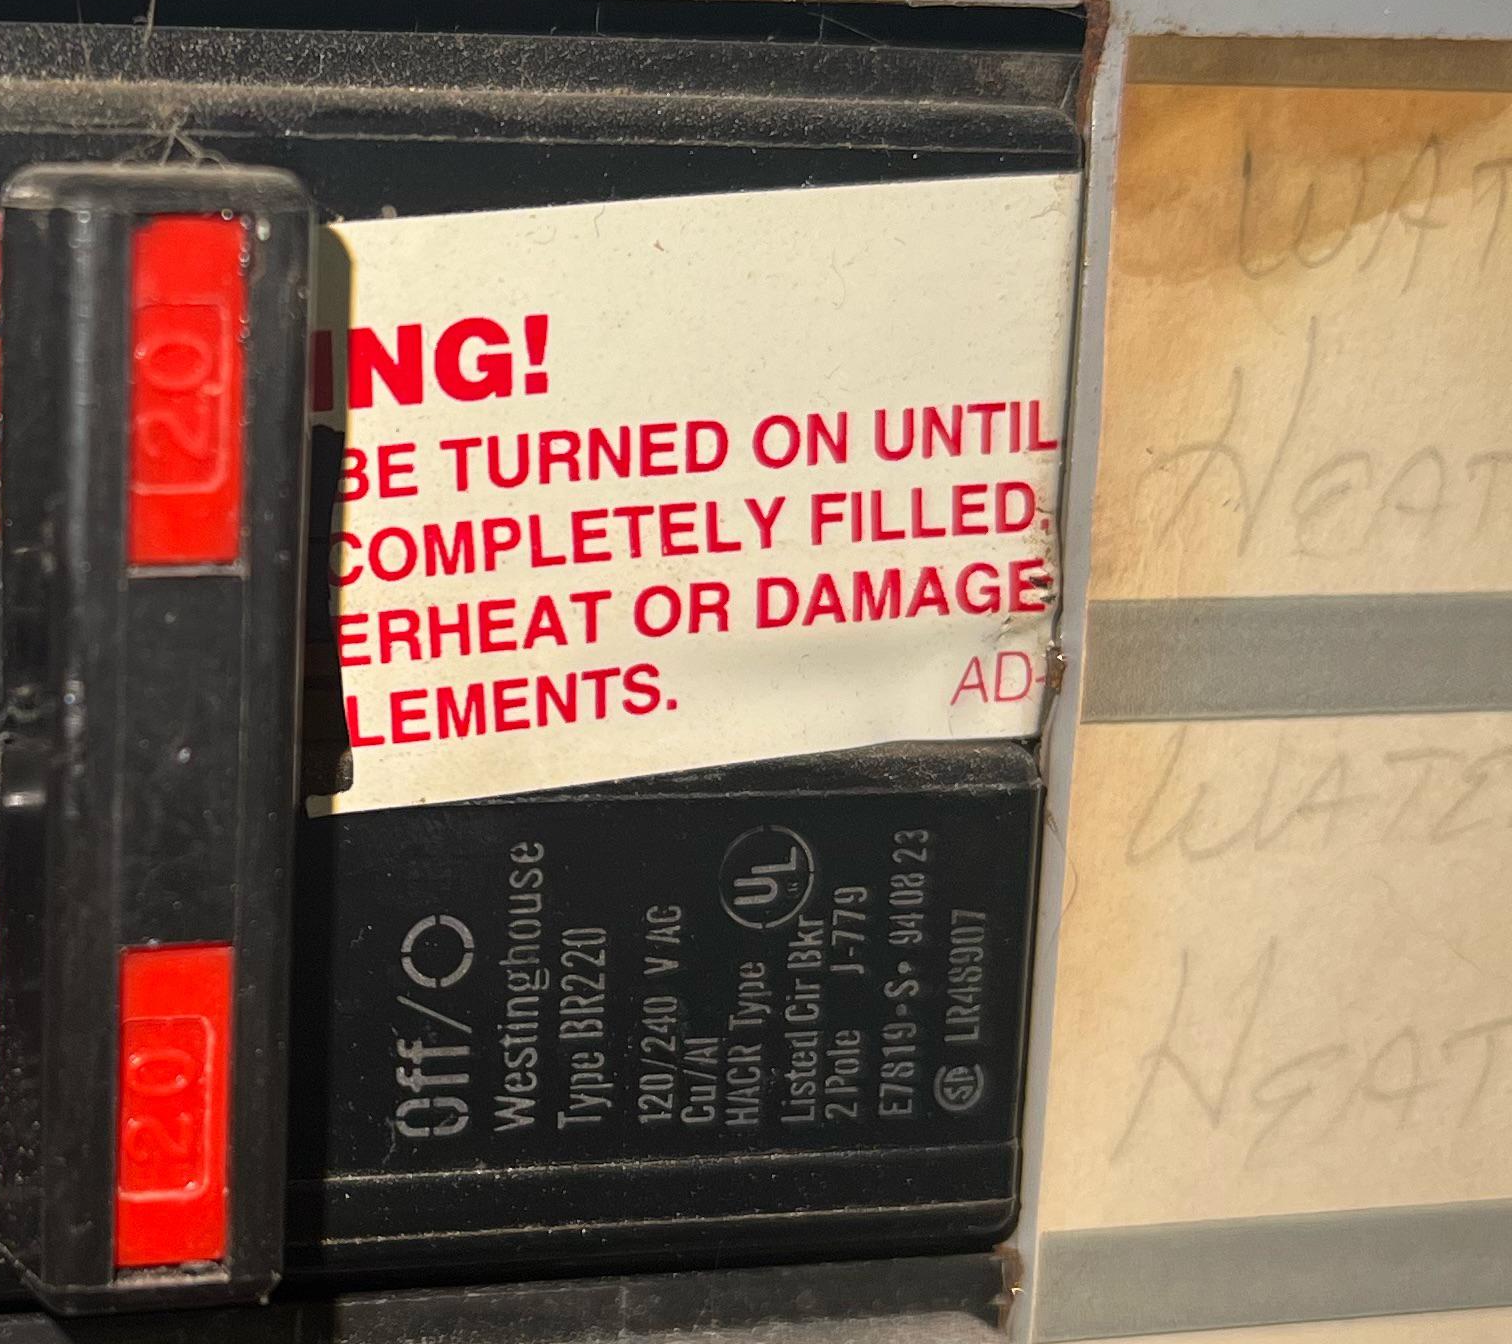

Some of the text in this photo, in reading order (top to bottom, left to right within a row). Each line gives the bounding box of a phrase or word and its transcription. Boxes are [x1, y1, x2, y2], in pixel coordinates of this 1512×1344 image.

[329, 480, 1051, 588] COMPLETELY FILLED.
[335, 399, 1058, 503] BE TURNED ON UNTIL
[634, 581, 730, 637] OR
[756, 558, 1053, 630] DAMAGE
[493, 841, 551, 1132] Westinghouse
[557, 927, 614, 1130] Type BR220
[637, 905, 683, 1124] 120/240 V AC
[725, 961, 773, 1127] HACR Type
[781, 913, 825, 1123] Listed Cir Bkr
[824, 885, 869, 1121] 2 Pole J-779
